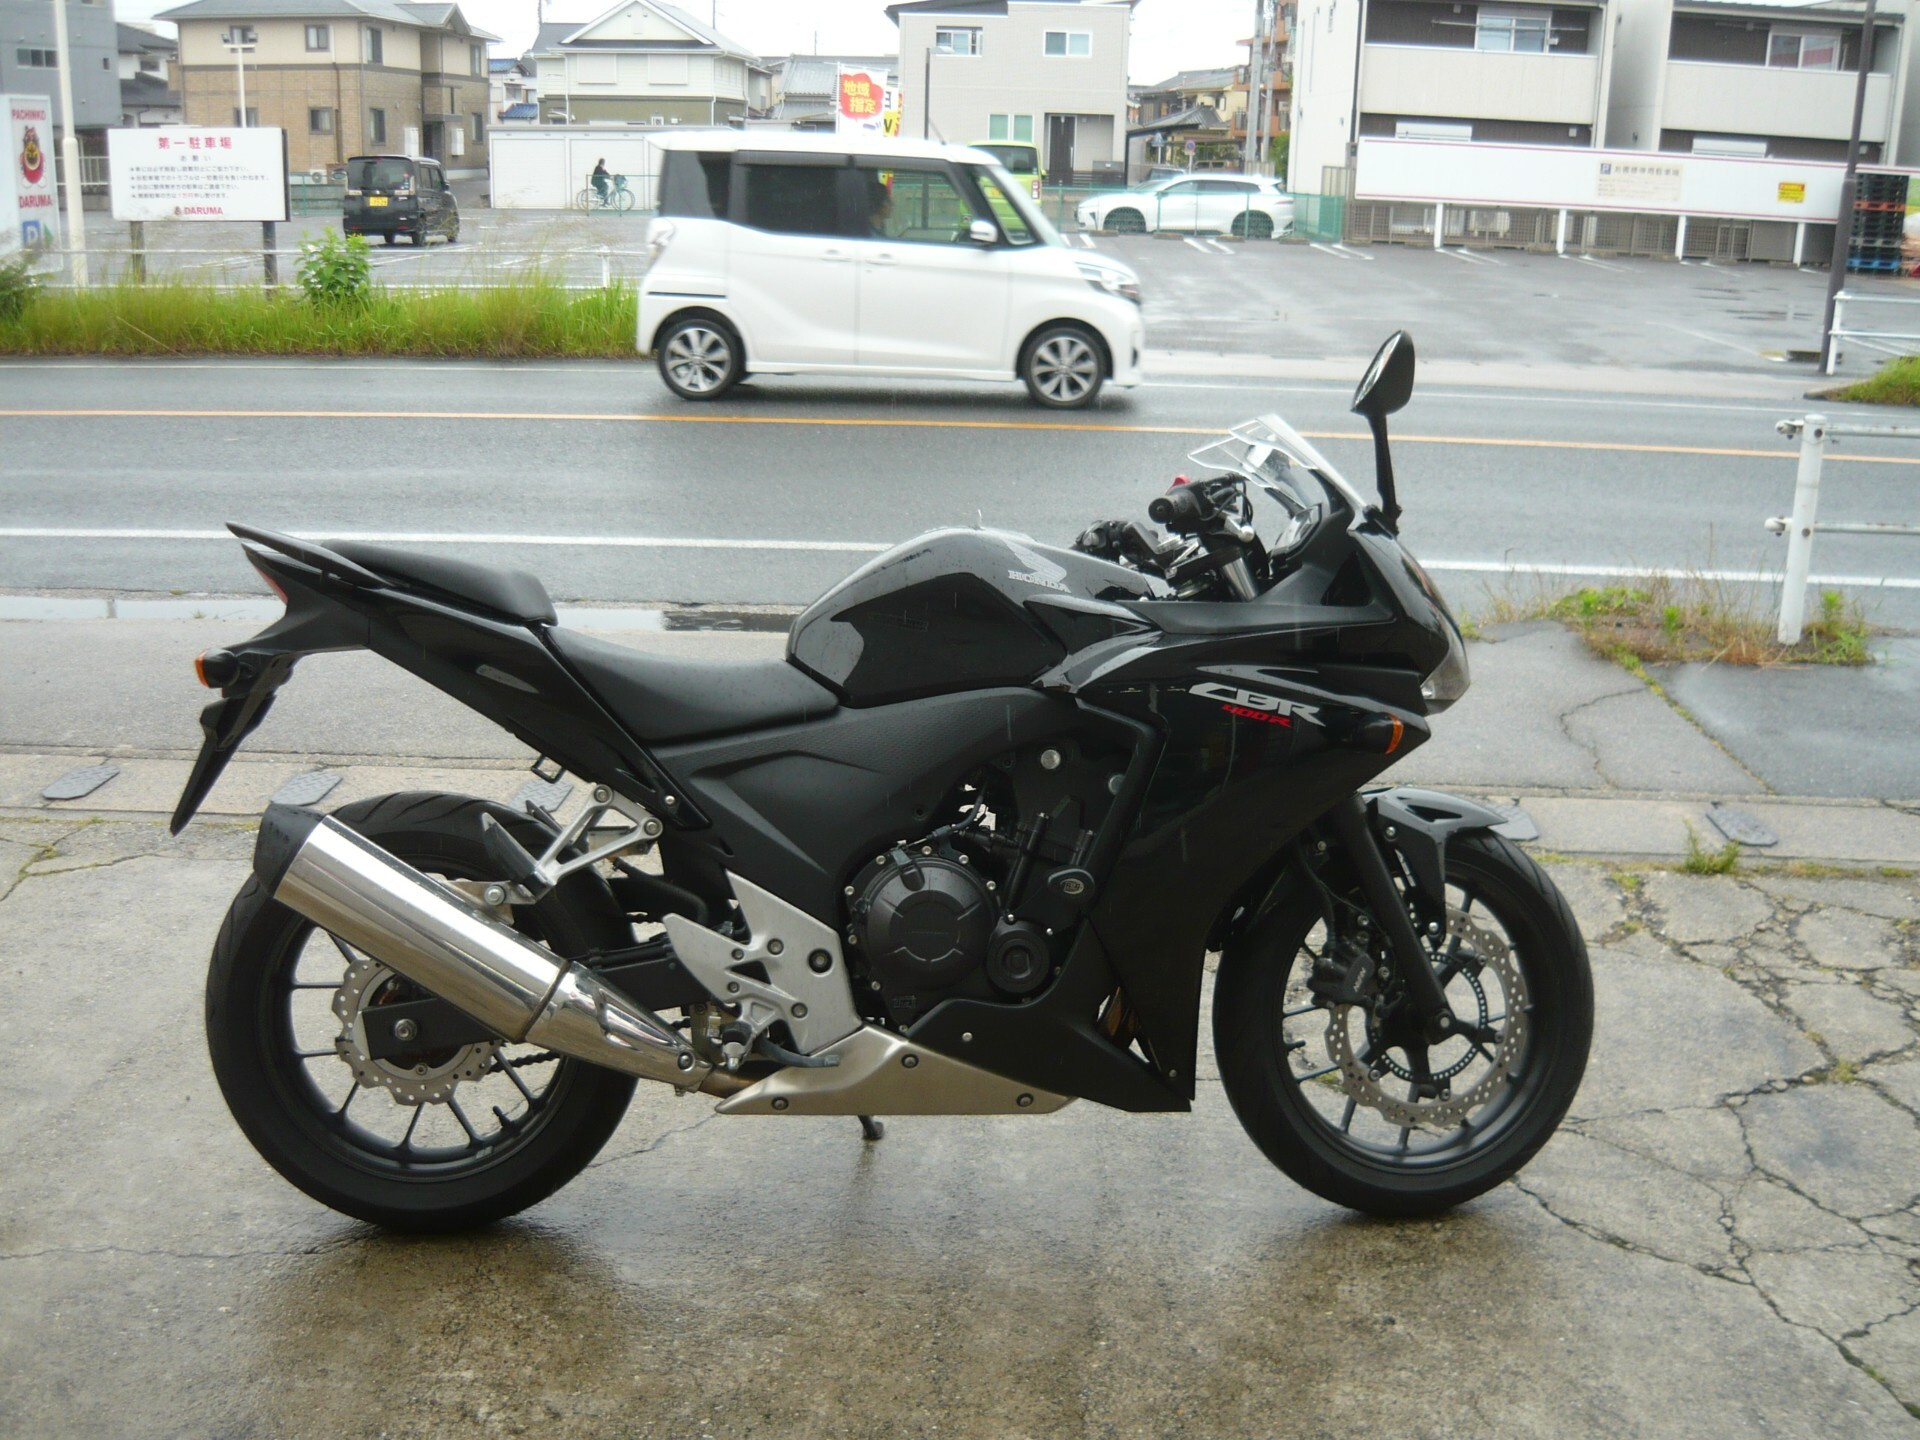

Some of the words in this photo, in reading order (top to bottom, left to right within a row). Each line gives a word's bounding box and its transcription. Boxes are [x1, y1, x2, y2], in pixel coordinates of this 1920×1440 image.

[843, 79, 870, 97] 地域
[849, 97, 876, 114] 指定
[12, 109, 47, 121] PACHINKO
[158, 136, 233, 149] 第一駐車場
[19, 194, 53, 209] DARUMA
[184, 206, 223, 215] DARUMA
[1007, 569, 1072, 593] HONDA
[1188, 682, 1326, 727] CBR
[1221, 704, 1294, 728] 400R
